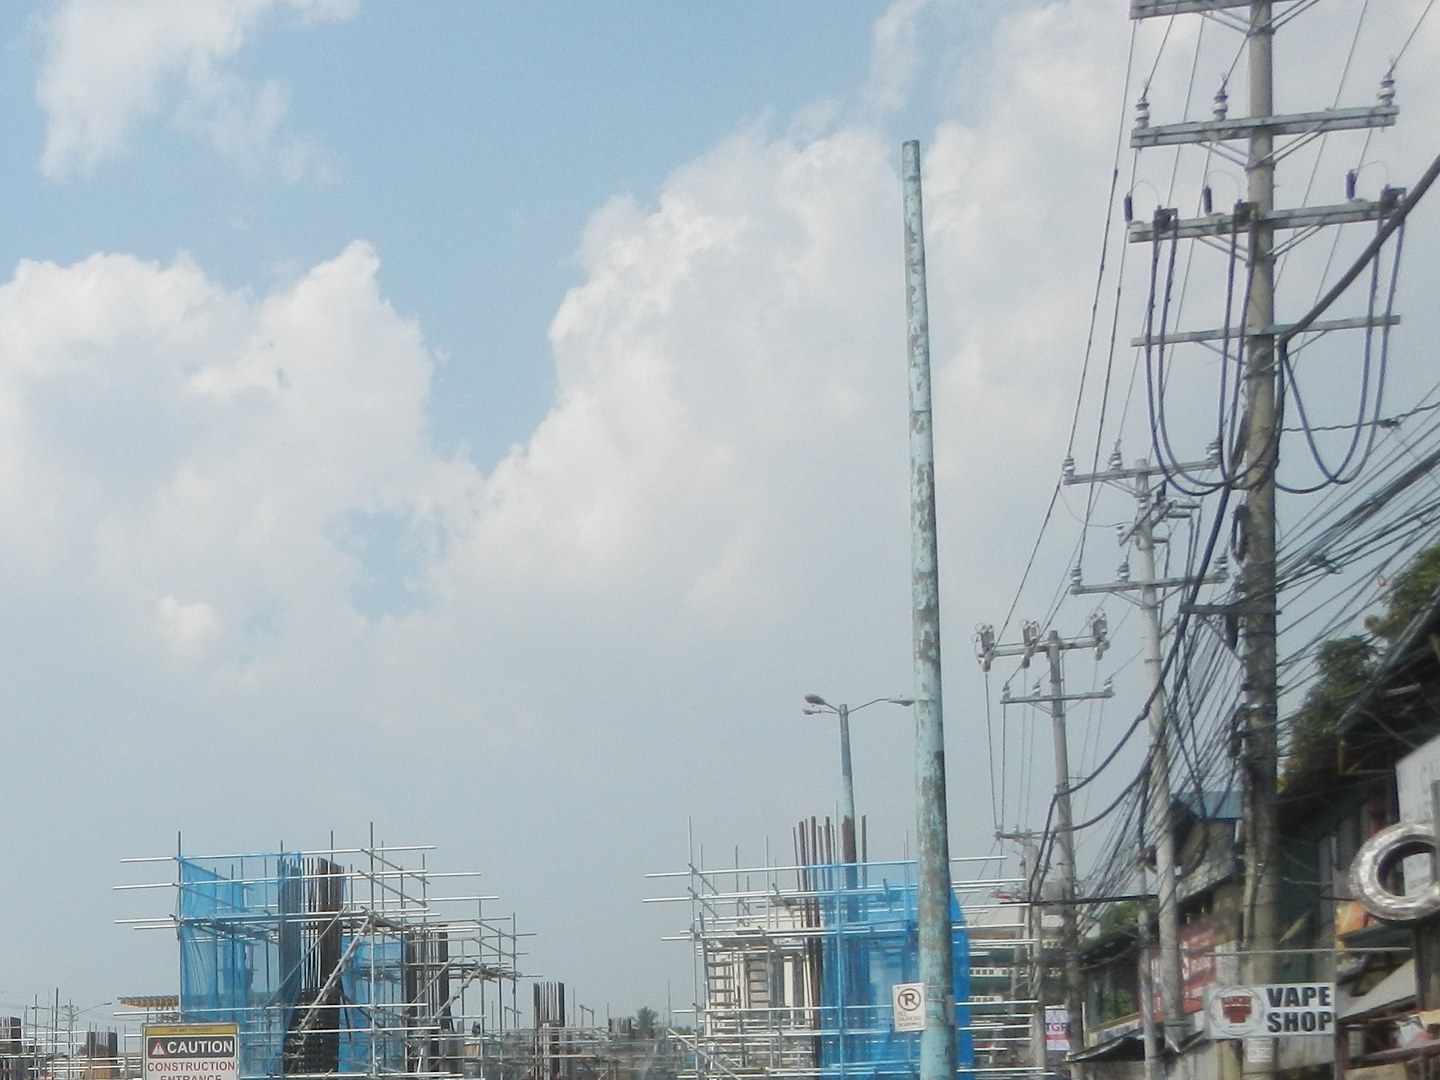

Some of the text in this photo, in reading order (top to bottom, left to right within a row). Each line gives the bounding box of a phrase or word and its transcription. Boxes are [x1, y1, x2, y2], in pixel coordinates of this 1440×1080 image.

[1266, 986, 1331, 1008] VAPE
[1267, 1011, 1333, 1033] SHOP
[167, 1040, 233, 1053] CAUTION
[147, 1061, 235, 1072] CONSTRUCTION
